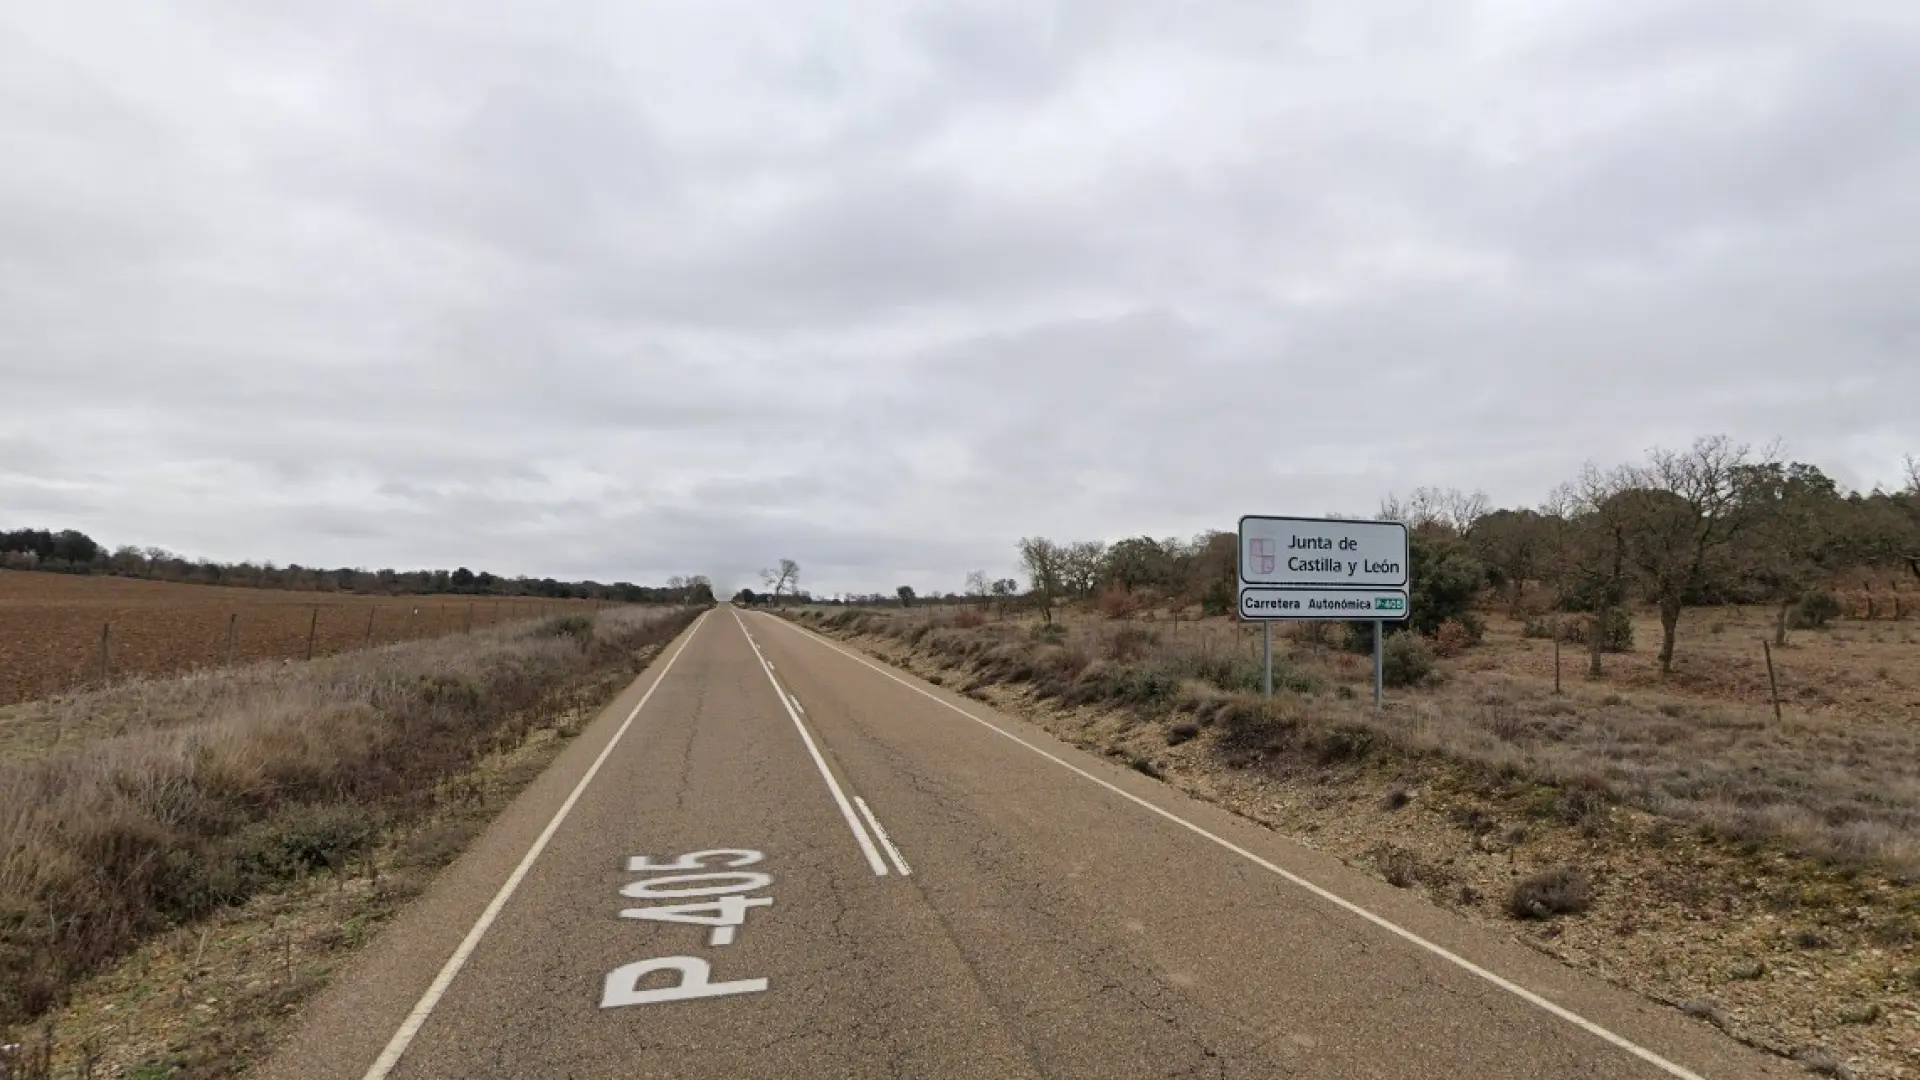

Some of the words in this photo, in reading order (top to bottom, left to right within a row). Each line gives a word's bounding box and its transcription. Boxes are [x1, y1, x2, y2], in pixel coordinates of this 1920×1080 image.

[1288, 534, 1332, 550] Junta
[1338, 536, 1358, 551] de
[1287, 556, 1342, 572] Castilla
[1348, 560, 1357, 576] y
[1364, 558, 1400, 573] León
[1245, 597, 1300, 609] Carretera
[1308, 598, 1371, 610] Autonómica
